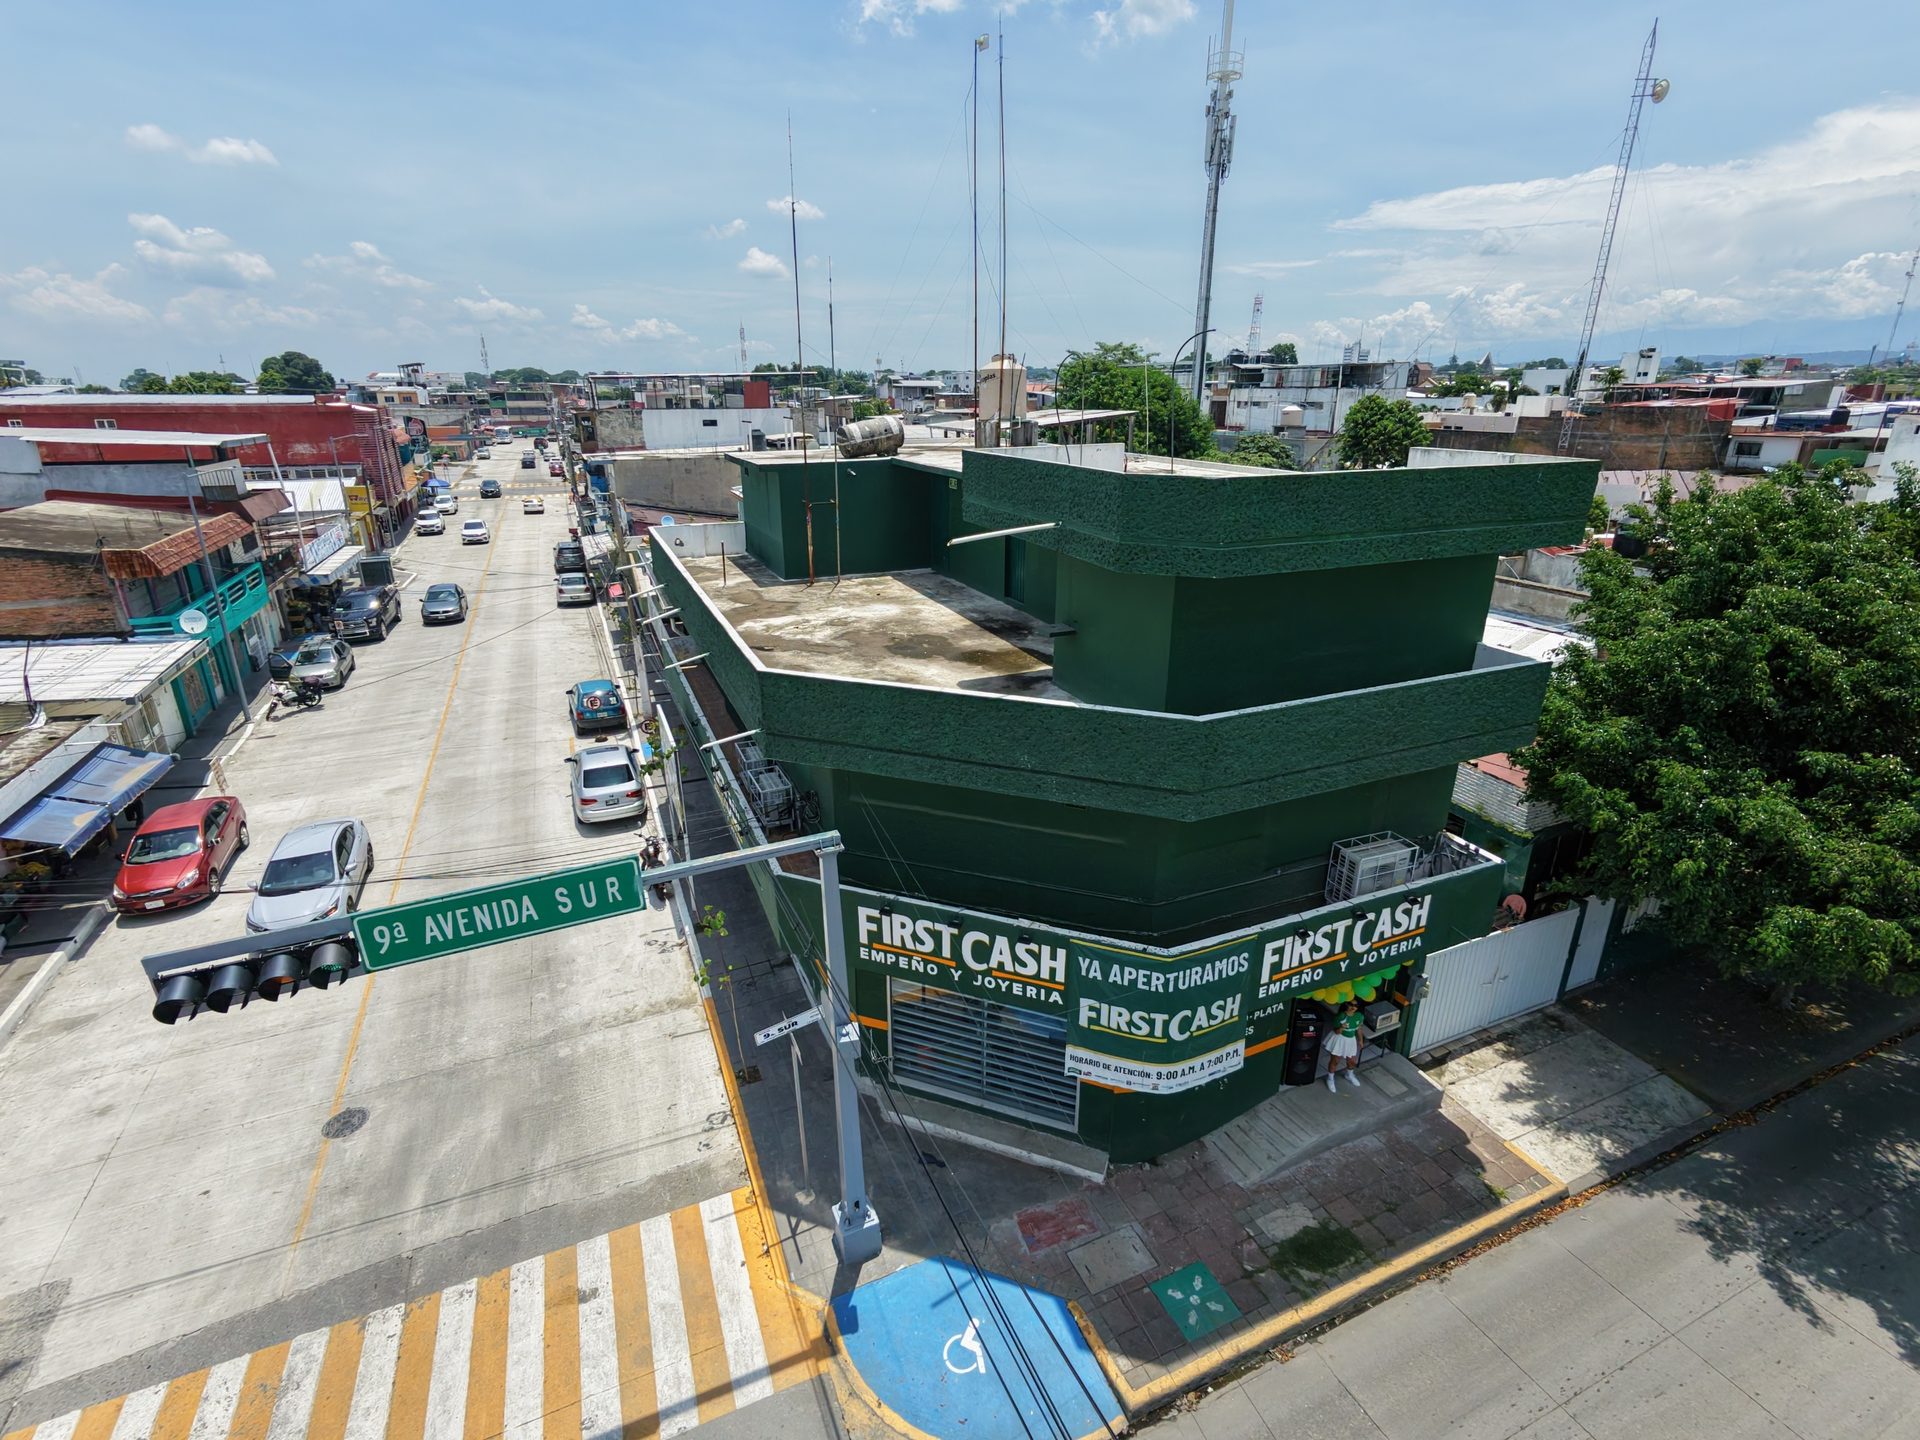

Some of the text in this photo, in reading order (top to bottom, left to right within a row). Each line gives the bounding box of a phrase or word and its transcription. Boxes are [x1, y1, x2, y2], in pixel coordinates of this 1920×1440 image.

[425, 895, 539, 945] AVENIDA
[554, 876, 623, 914] SUR
[857, 905, 1067, 983] FIRST CASH
[1260, 894, 1432, 985] FIRST CASH
[859, 946, 1064, 1005] EMPEÑO Y JOYERIA
[1078, 952, 1249, 993] YA APERTURAMOS
[1258, 936, 1422, 999] EMPEÑO Y JOYERIA
[777, 1020, 798, 1033] SUR
[1078, 993, 1242, 1042] FIRST CASH
[1253, 1002, 1284, 1020] PLATA
[1069, 1053, 1101, 1068] HORARIO
[1102, 1062, 1112, 1071] DE
[1113, 1065, 1154, 1080] ATENCIÓN:
[1156, 1070, 1178, 1080] 9:00
[1180, 1066, 1197, 1078] A.M.
[1199, 1062, 1205, 1071] A
[1207, 1053, 1224, 1069] 7:00
[1225, 1048, 1241, 1062] P.M.
